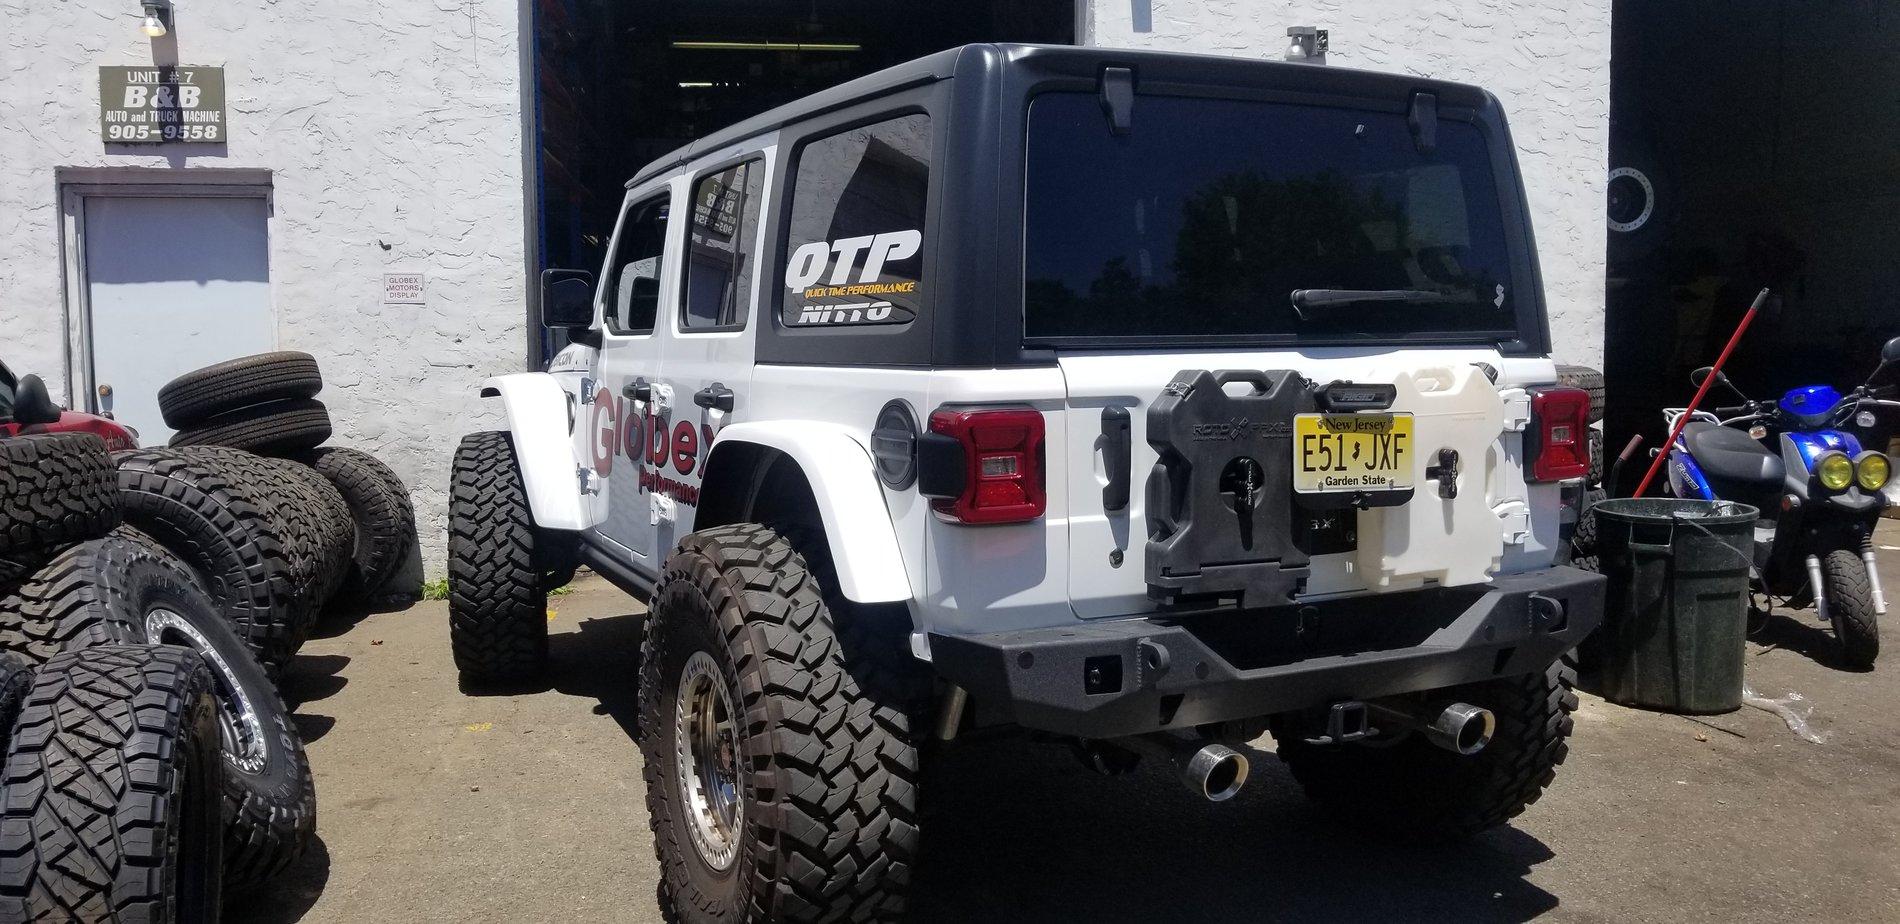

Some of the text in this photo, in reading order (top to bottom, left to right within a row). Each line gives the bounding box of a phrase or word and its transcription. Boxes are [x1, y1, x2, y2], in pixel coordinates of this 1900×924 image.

[127, 71, 194, 83] UNIT # 7
[105, 111, 220, 123] AUTO and TRUCK MACHINE
[109, 125, 218, 139] 905-9558
[784, 229, 922, 294] QTP
[805, 281, 915, 299] QUICK TIME PERFORMANCE
[798, 301, 892, 323] NITTO
[1325, 416, 1386, 433] New Jersey
[1302, 433, 1407, 472] E51 JXF
[1325, 475, 1386, 486] Garden State
